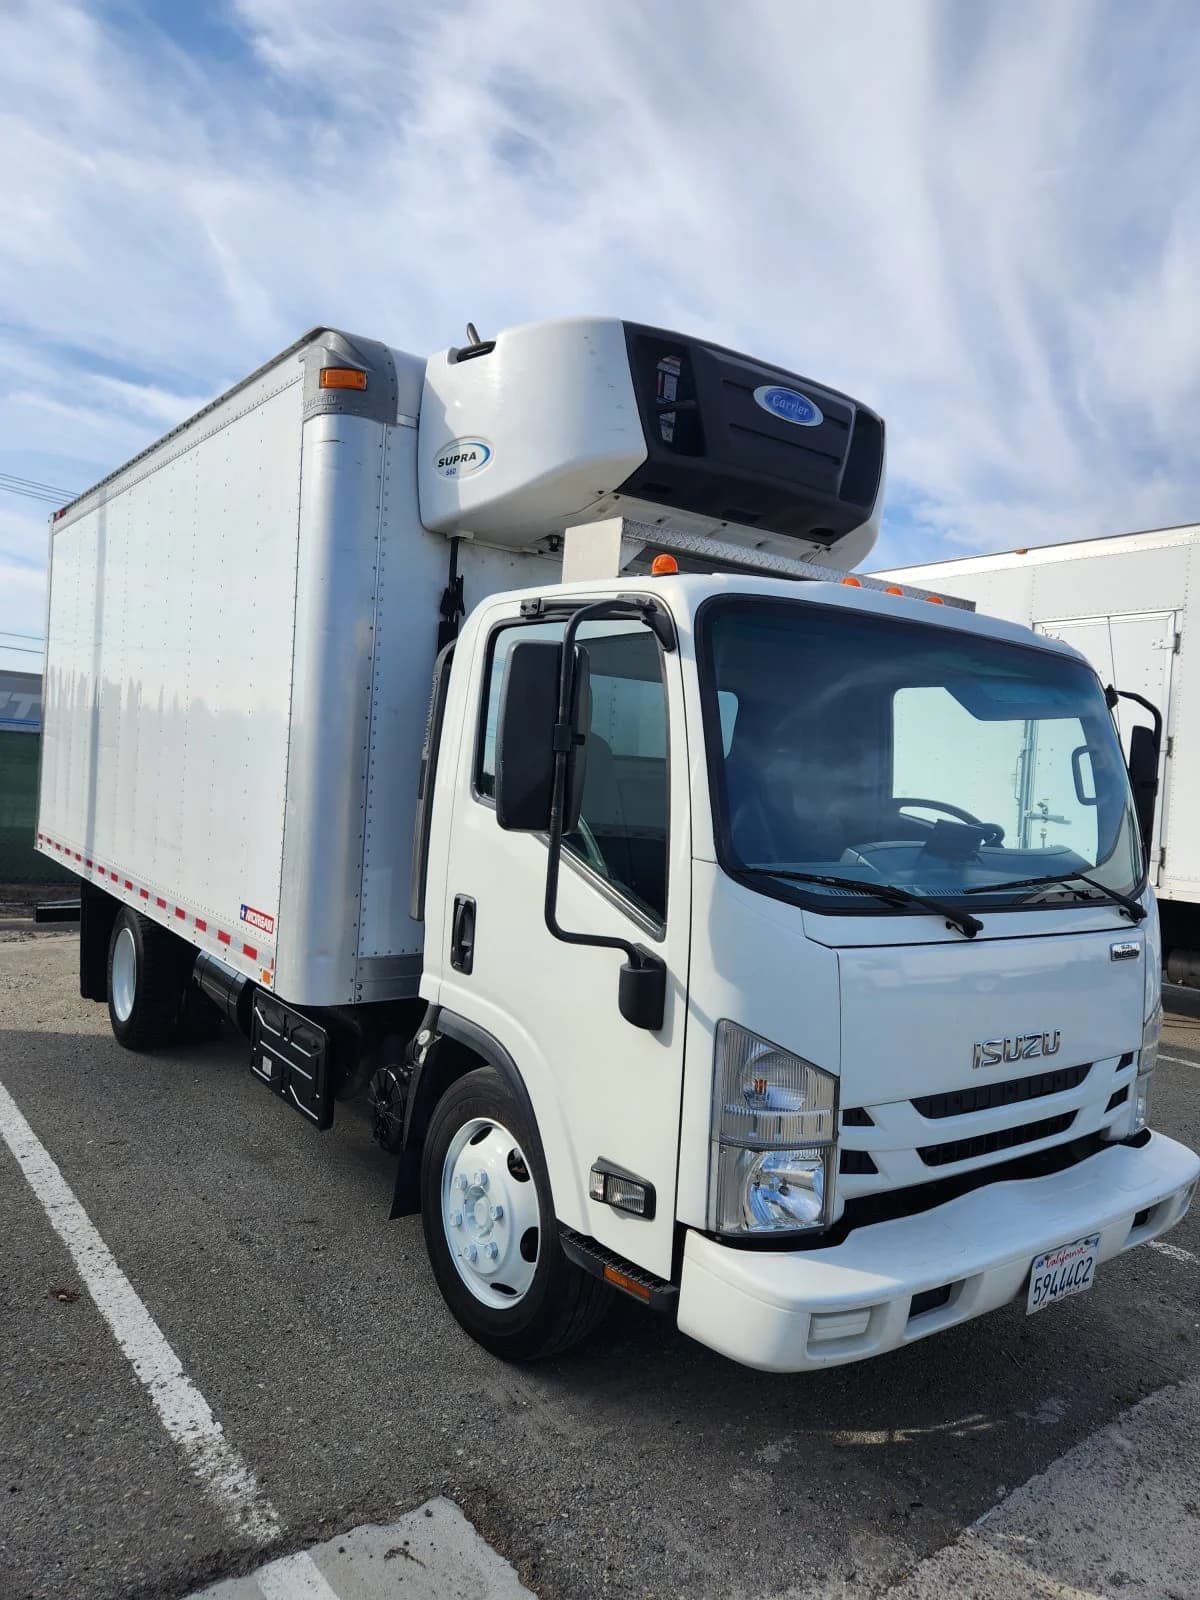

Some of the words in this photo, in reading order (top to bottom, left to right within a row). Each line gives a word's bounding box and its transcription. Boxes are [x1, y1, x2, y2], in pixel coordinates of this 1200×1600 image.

[772, 394, 810, 416] Carrier
[437, 451, 477, 468] SUPRA
[245, 909, 273, 931] MORGAN
[972, 1028, 1061, 1070] ISUZU
[1045, 1247, 1087, 1269] California
[1032, 1256, 1093, 1306] 59444C2
